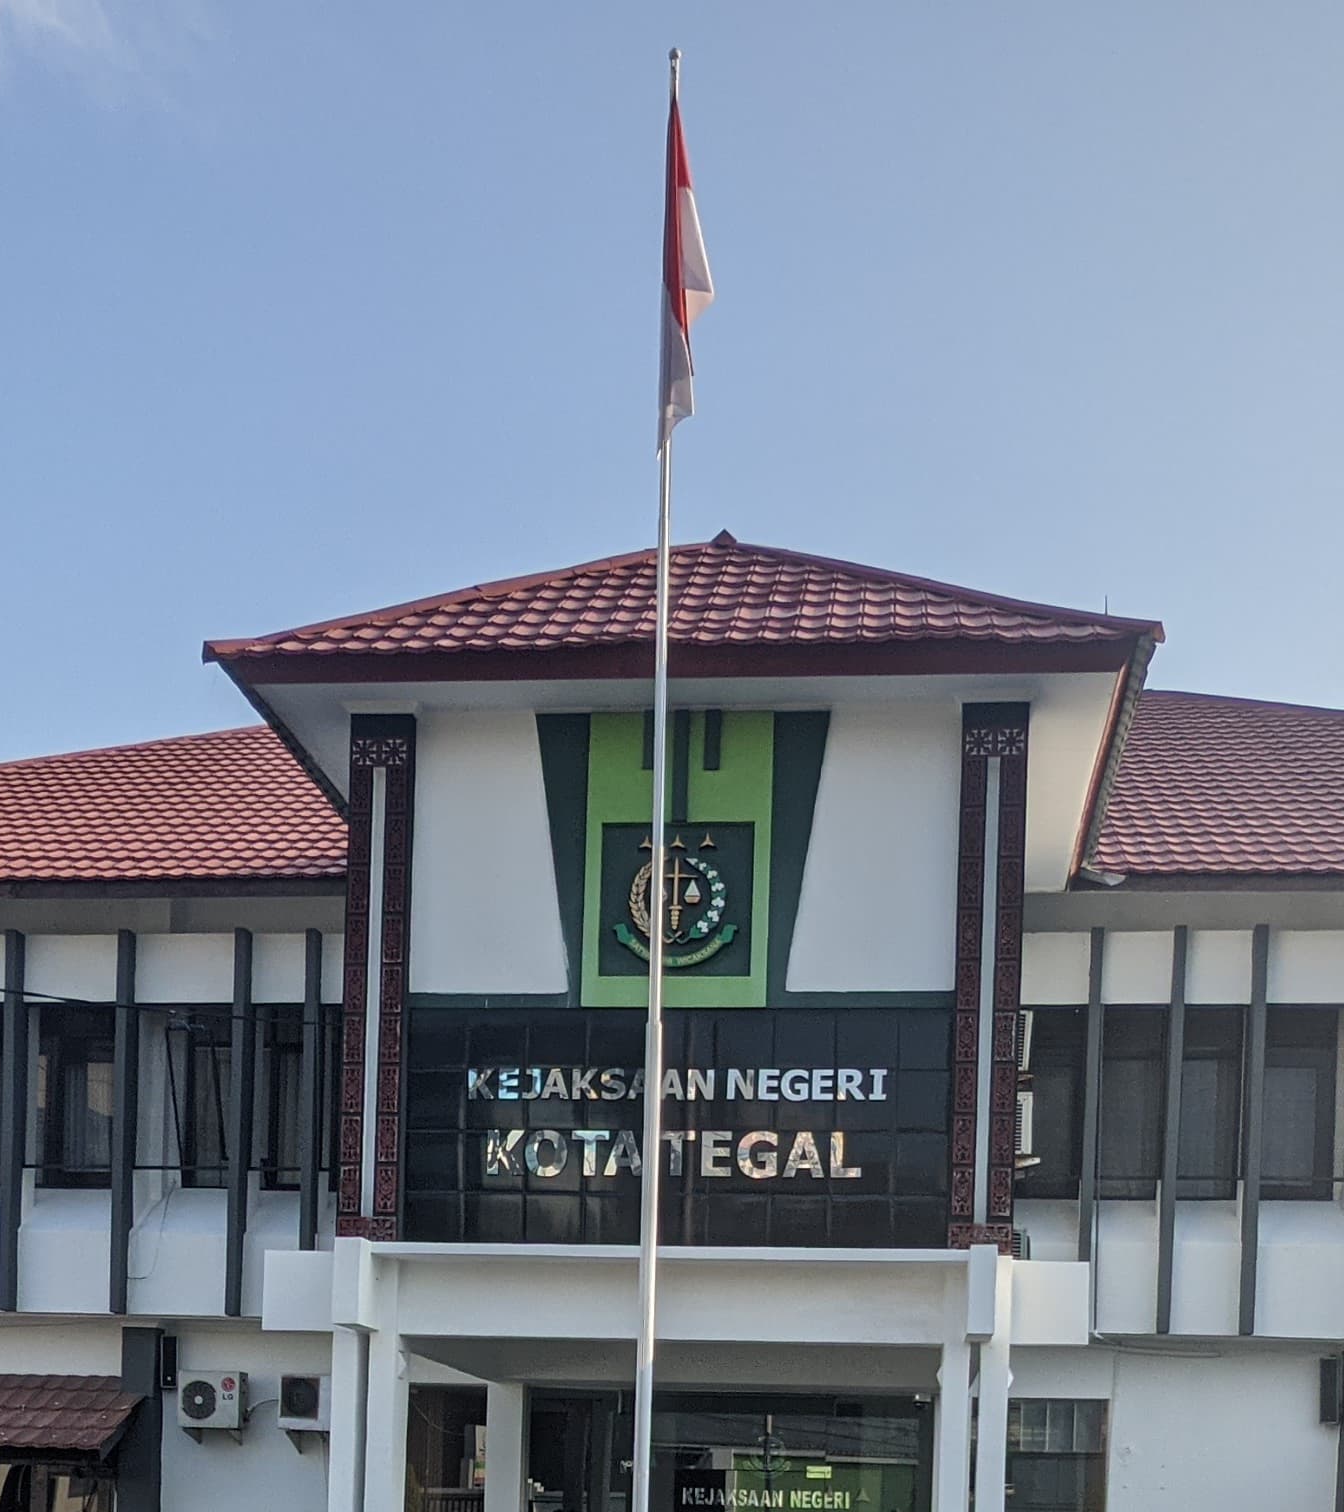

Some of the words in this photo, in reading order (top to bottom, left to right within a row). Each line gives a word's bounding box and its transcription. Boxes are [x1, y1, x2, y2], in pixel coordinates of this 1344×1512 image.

[467, 1068, 715, 1101] KEJAKSAAN
[726, 1068, 888, 1101] NEGERI
[485, 1129, 642, 1177] KOTA
[660, 1130, 862, 1179] TEGAL
[682, 1486, 783, 1508] KEJAKSAAN
[790, 1489, 851, 1510] NEGERI
